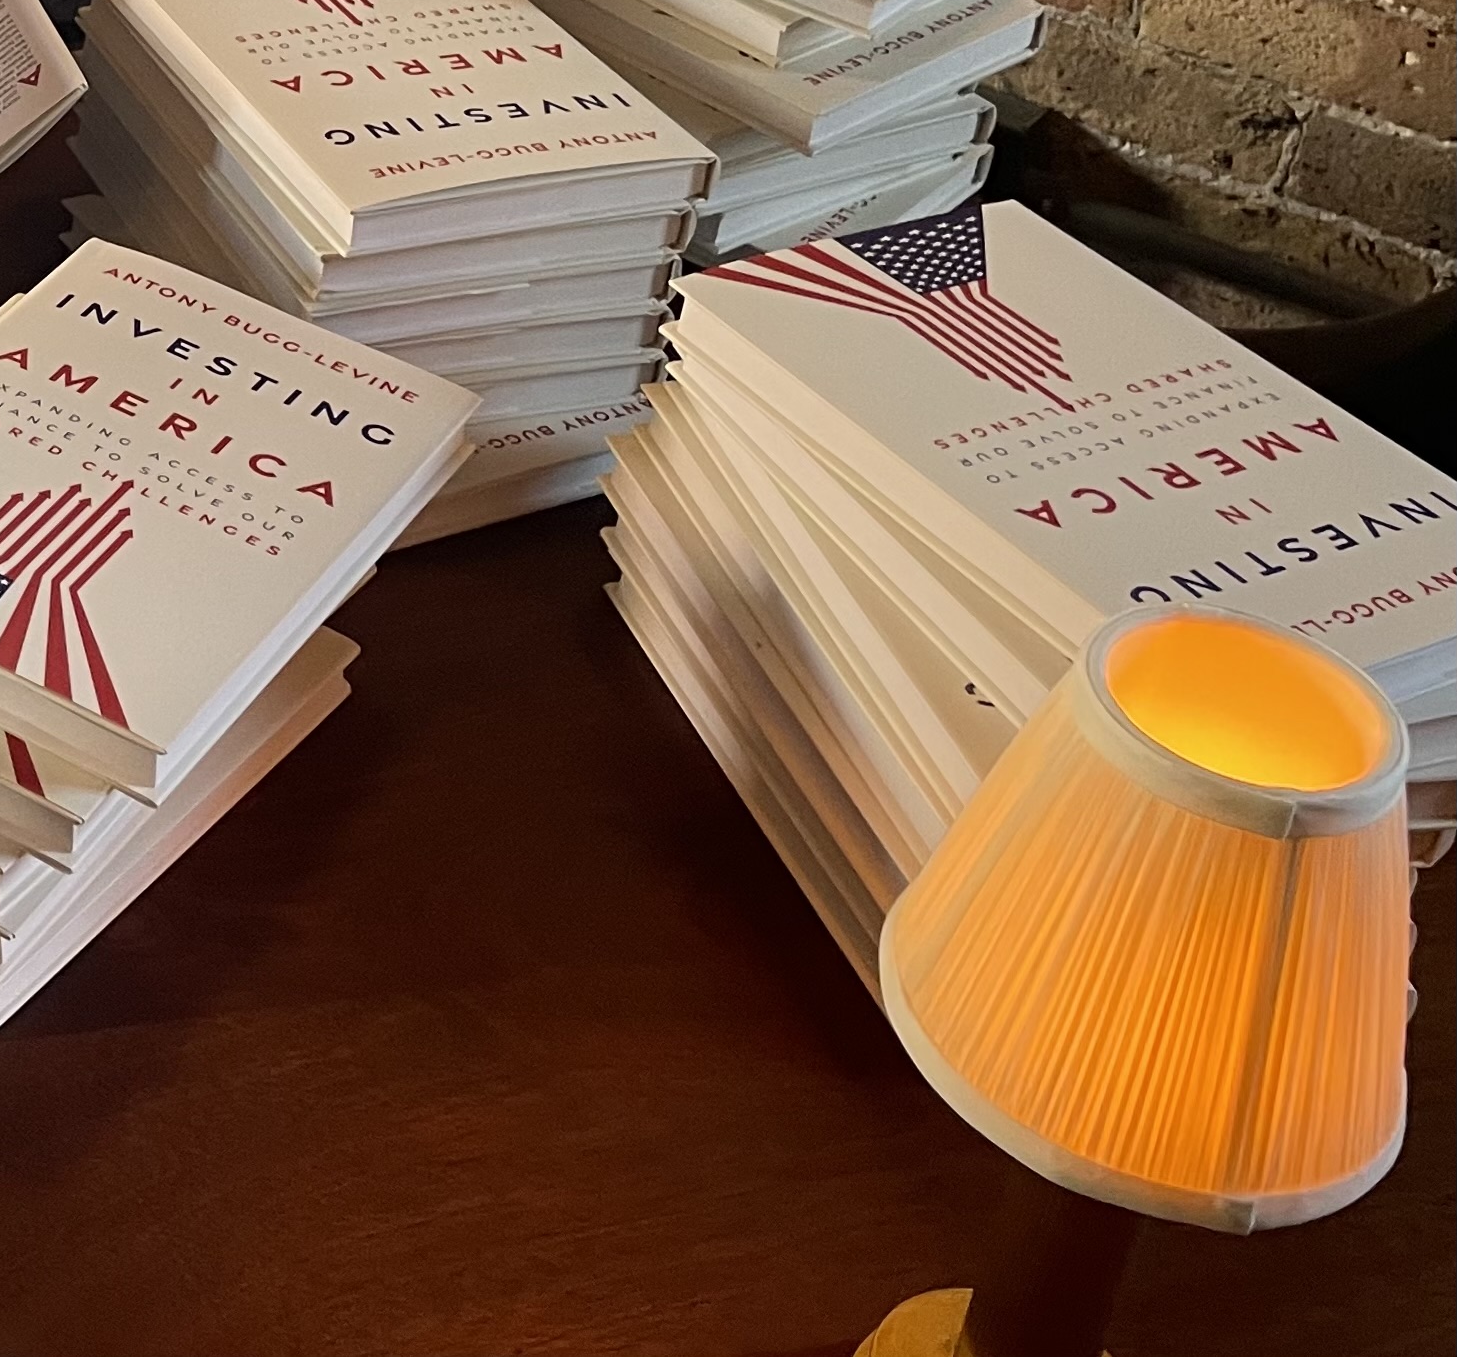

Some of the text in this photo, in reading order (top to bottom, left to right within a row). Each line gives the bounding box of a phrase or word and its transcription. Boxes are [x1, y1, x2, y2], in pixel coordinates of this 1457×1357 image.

[270, 43, 565, 94] AMERICA
[802, 25, 925, 87] BUGG-LEVINE
[430, 83, 474, 99] IN
[324, 92, 632, 146] INVESTING
[369, 130, 658, 180] ANTONY BUGG-LEVINE
[103, 267, 420, 404] ANTONY BUGG-LEVINE
[55, 293, 396, 446] INVESTING
[169, 377, 220, 406] IN
[1125, 358, 1232, 394] SHARED
[564, 399, 653, 431] ANTONY
[957, 375, 1259, 467] FINANCE TO SOLVE OUR
[986, 391, 1282, 484] EXPANDING ACCESS TO
[94, 444, 121, 461] TO
[138, 466, 224, 507] SOLVE
[241, 512, 295, 541] OUR
[148, 451, 254, 502] ACCESS
[274, 504, 304, 525] TO
[1014, 417, 1341, 528] AMERICA
[1215, 497, 1272, 524] IN
[1290, 587, 1415, 636] BUGG-L
